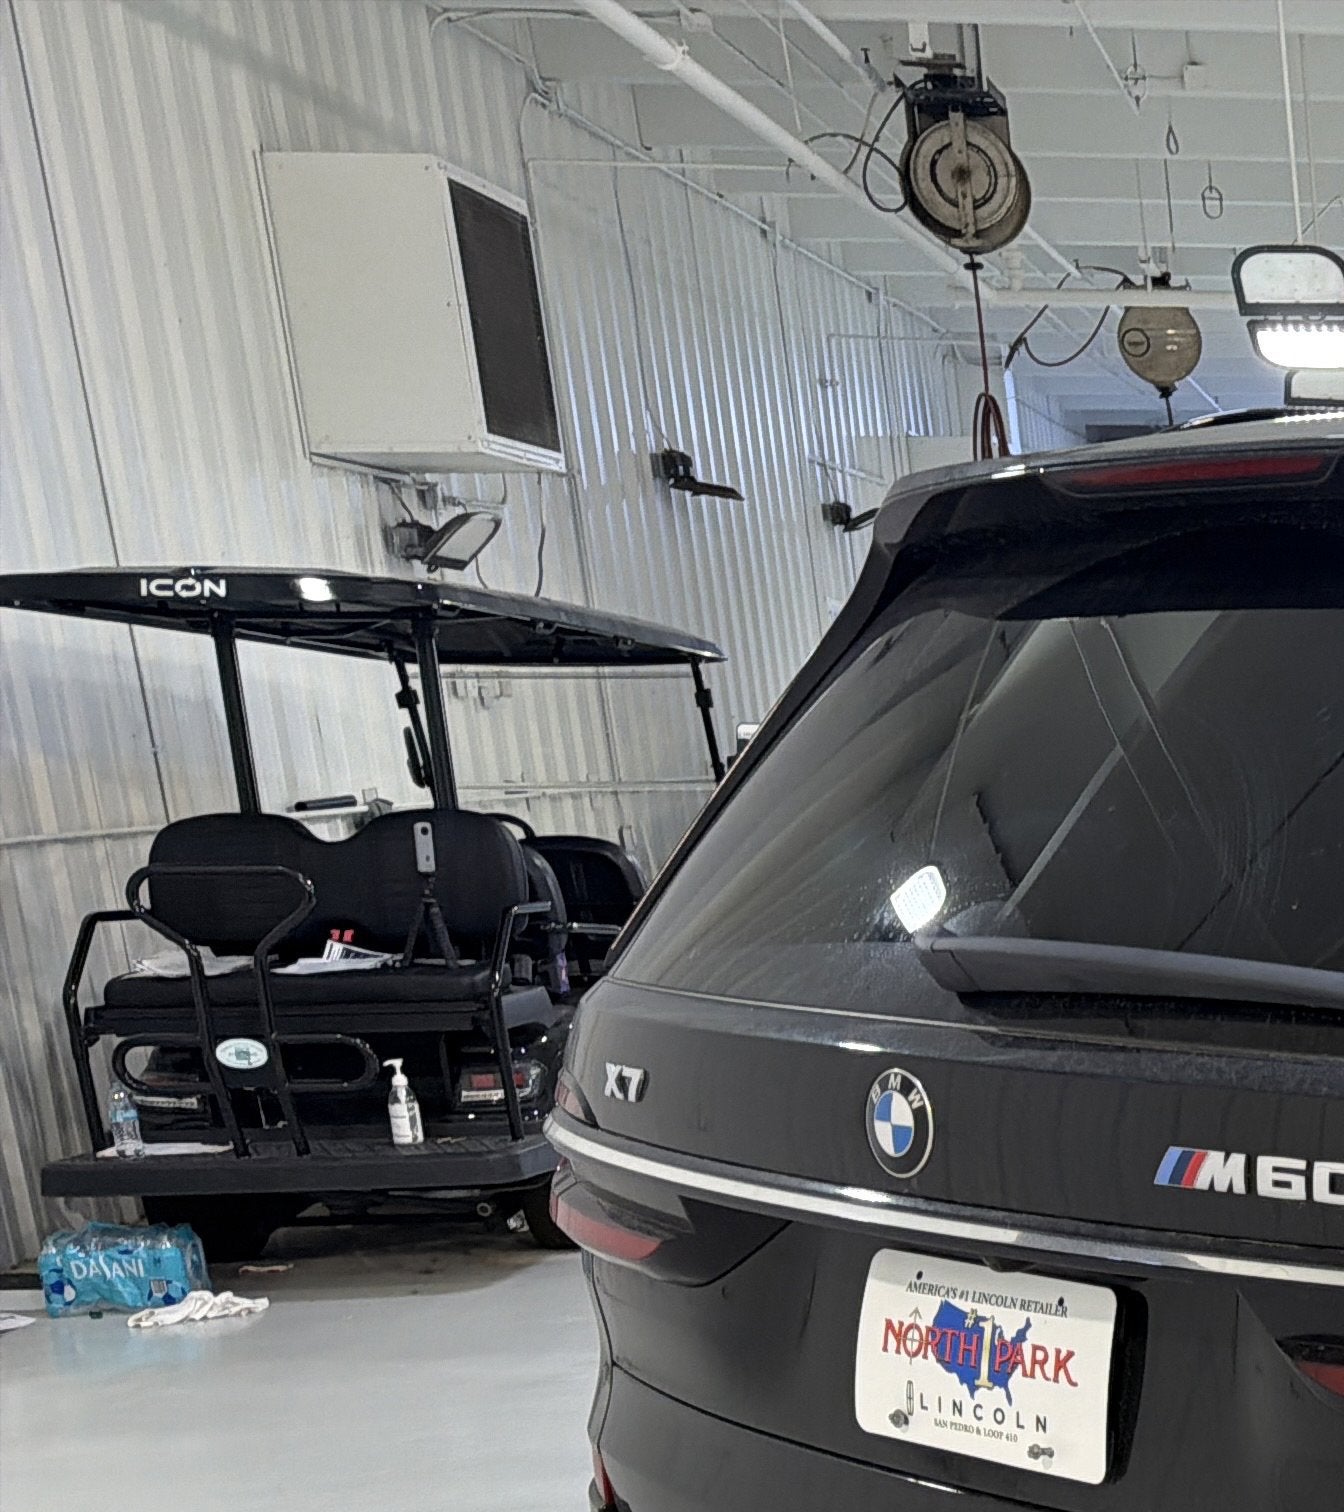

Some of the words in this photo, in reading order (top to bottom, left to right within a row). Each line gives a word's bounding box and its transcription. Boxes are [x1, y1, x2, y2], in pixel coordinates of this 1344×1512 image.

[140, 577, 227, 598] ICON
[604, 1061, 645, 1102] X7
[871, 1073, 924, 1110] BMW
[70, 1252, 145, 1281] DASANI
[905, 1280, 958, 1299] AMERICA'S
[958, 1289, 970, 1302] #1
[971, 1290, 1018, 1310] LINCOLN
[1019, 1299, 1068, 1318] RETAILER
[882, 1318, 980, 1368] NORTH
[994, 1339, 1079, 1387] PARK
[919, 1392, 1048, 1434] LINCOLN
[949, 1421, 975, 1434] PEDRO
